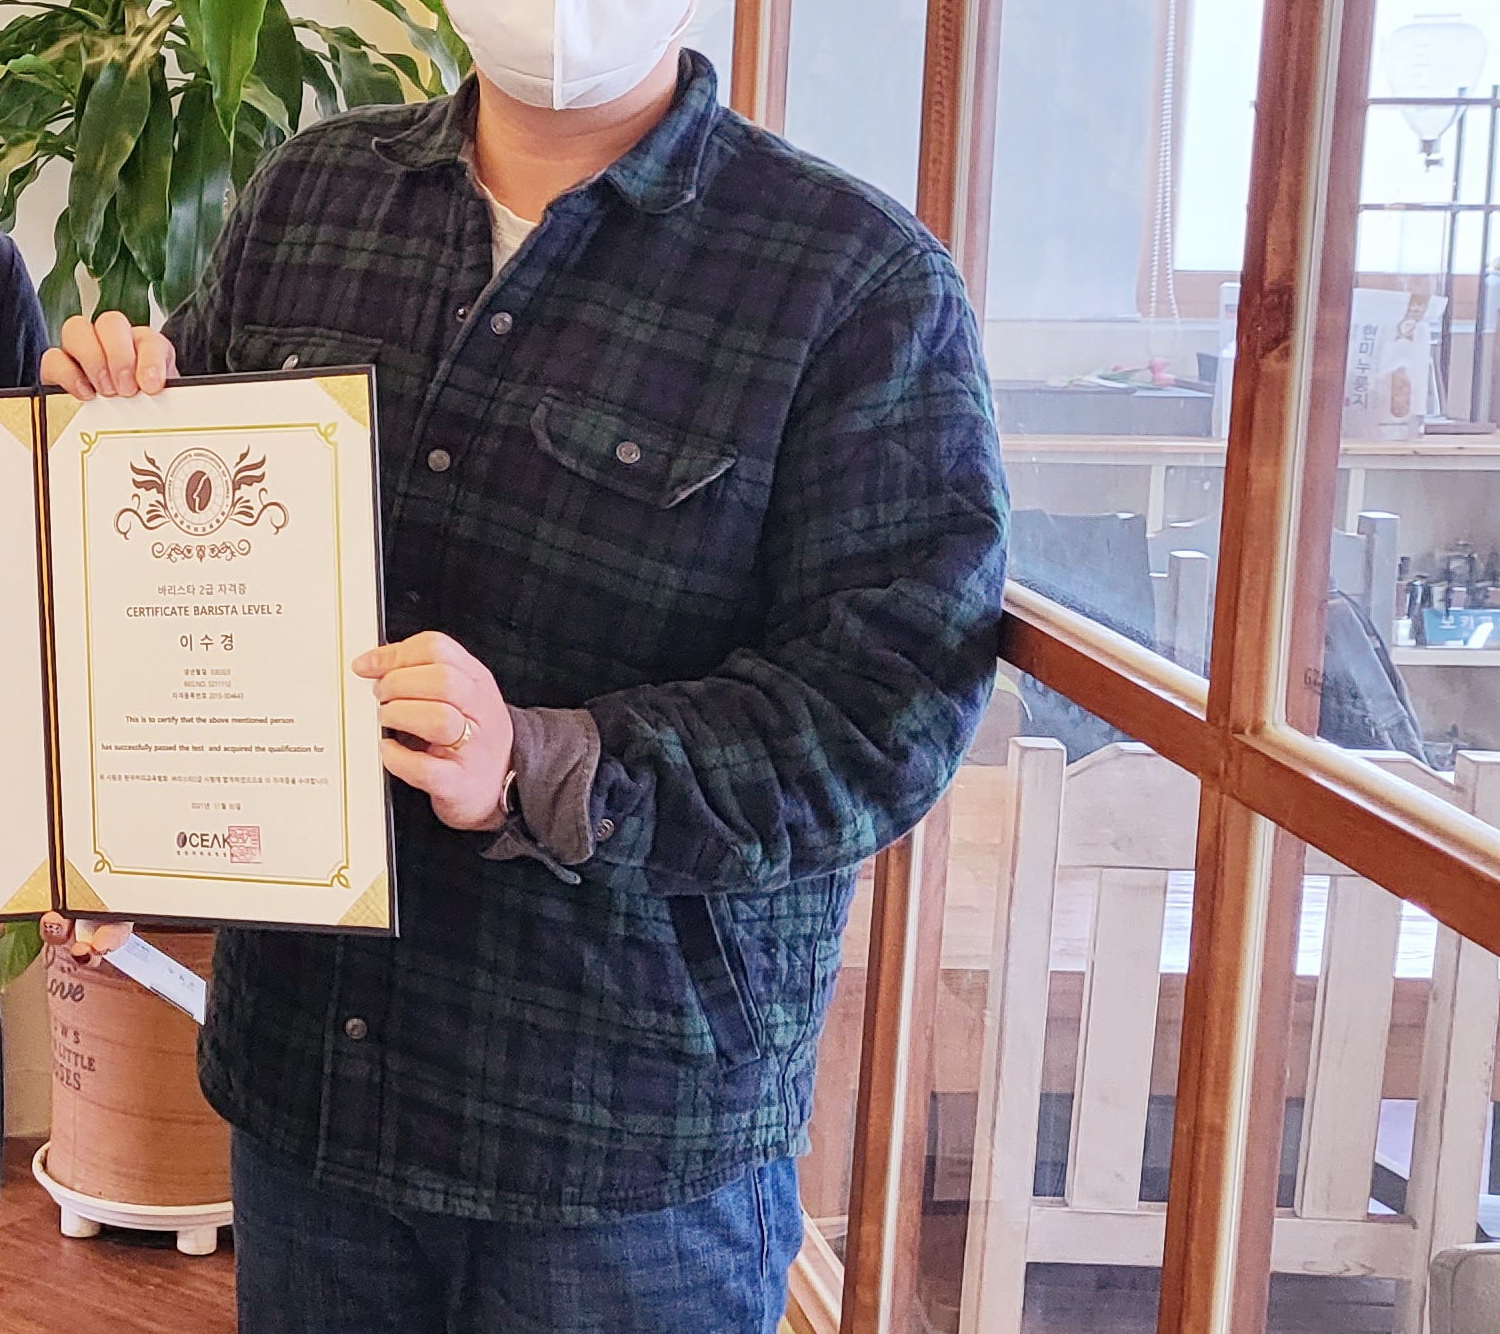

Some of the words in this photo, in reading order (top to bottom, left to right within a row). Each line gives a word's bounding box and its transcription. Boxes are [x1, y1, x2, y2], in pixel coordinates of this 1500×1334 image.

[157, 584, 196, 596] 바리스타
[199, 584, 214, 595] 2급
[217, 583, 247, 595] 자격증
[126, 606, 190, 617] CERTIFICATE
[193, 605, 239, 616] BARISTA
[242, 604, 272, 615] LEVEL
[275, 604, 283, 615] 2
[125, 715, 139, 723] This
[141, 715, 147, 723] is
[157, 715, 179, 725] certify
[101, 743, 113, 751] has
[179, 744, 190, 752] the
[314, 745, 325, 753] for
